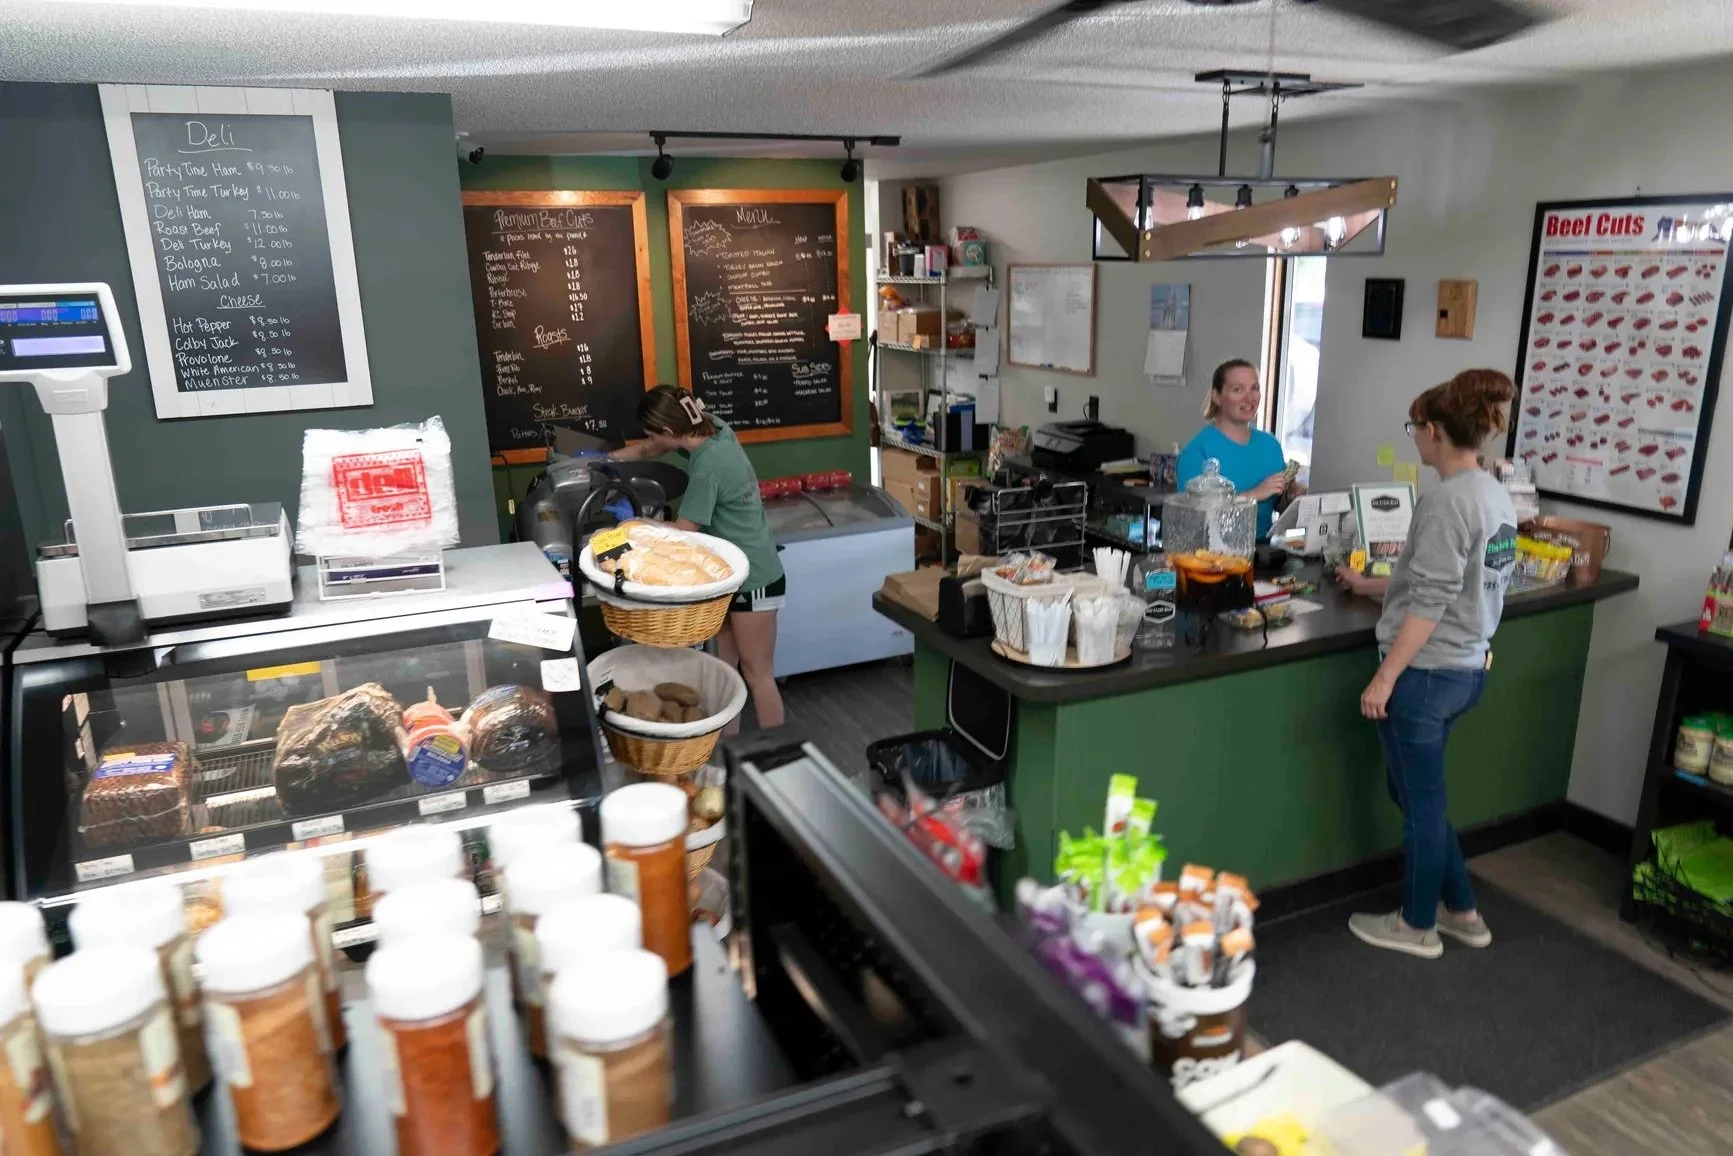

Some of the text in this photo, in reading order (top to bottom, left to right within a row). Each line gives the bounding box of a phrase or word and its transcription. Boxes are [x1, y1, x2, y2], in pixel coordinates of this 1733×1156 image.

[185, 121, 236, 146] Deli
[144, 158, 182, 179] Party
[182, 162, 207, 177] Time
[212, 162, 241, 177] Ham
[146, 182, 181, 203] Party
[183, 186, 208, 198] Time
[210, 184, 249, 200] Turkey
[153, 205, 183, 219] Deli
[187, 205, 211, 219] Ham
[494, 209, 594, 230] Premium Beef Cuts
[736, 206, 774, 224] Menu
[153, 221, 188, 235] Roast
[192, 222, 222, 236] Beef
[1546, 212, 1645, 237] Beef Cuts
[161, 237, 185, 251] Deli
[190, 239, 232, 253] Turkey
[164, 256, 221, 273] Bologna
[565, 258, 579, 268] $18
[168, 275, 196, 292] Ham
[200, 272, 241, 291] Salad
[567, 269, 580, 280] $18
[568, 281, 580, 291] $18
[220, 294, 263, 308] Cheese
[571, 312, 584, 322] $12
[172, 317, 193, 334] Hot
[196, 317, 232, 337] Pepper
[535, 325, 568, 345] Roasts
[175, 337, 207, 352] Colby
[211, 335, 240, 350] Jack
[176, 352, 233, 367] Provolone
[181, 367, 210, 379] White
[213, 364, 260, 377] American
[533, 402, 588, 420] Steak Burger
